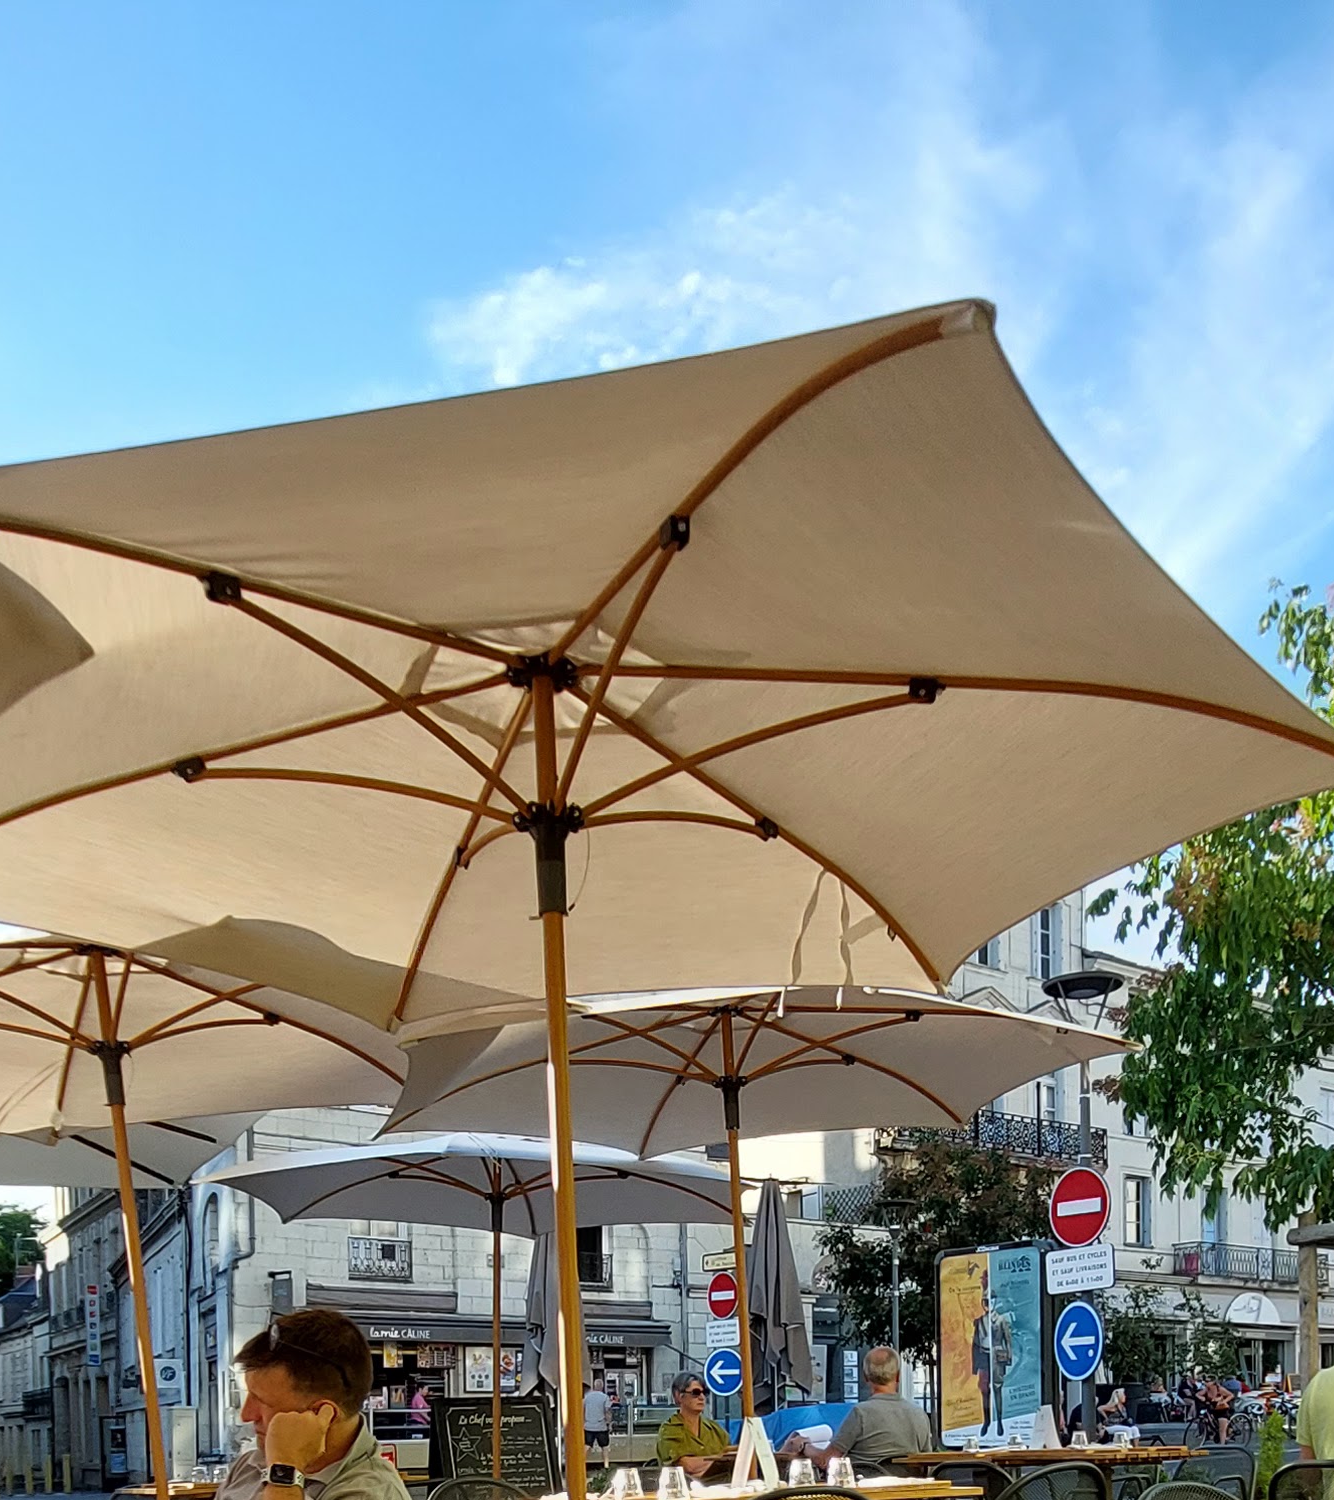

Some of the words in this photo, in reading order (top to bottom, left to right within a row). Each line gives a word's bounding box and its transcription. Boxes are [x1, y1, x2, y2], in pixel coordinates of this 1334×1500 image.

[1087, 1250, 1107, 1260] CYCLES
[1060, 1267, 1074, 1275] SAUF
[1075, 1263, 1107, 1273] LIVRAISONS
